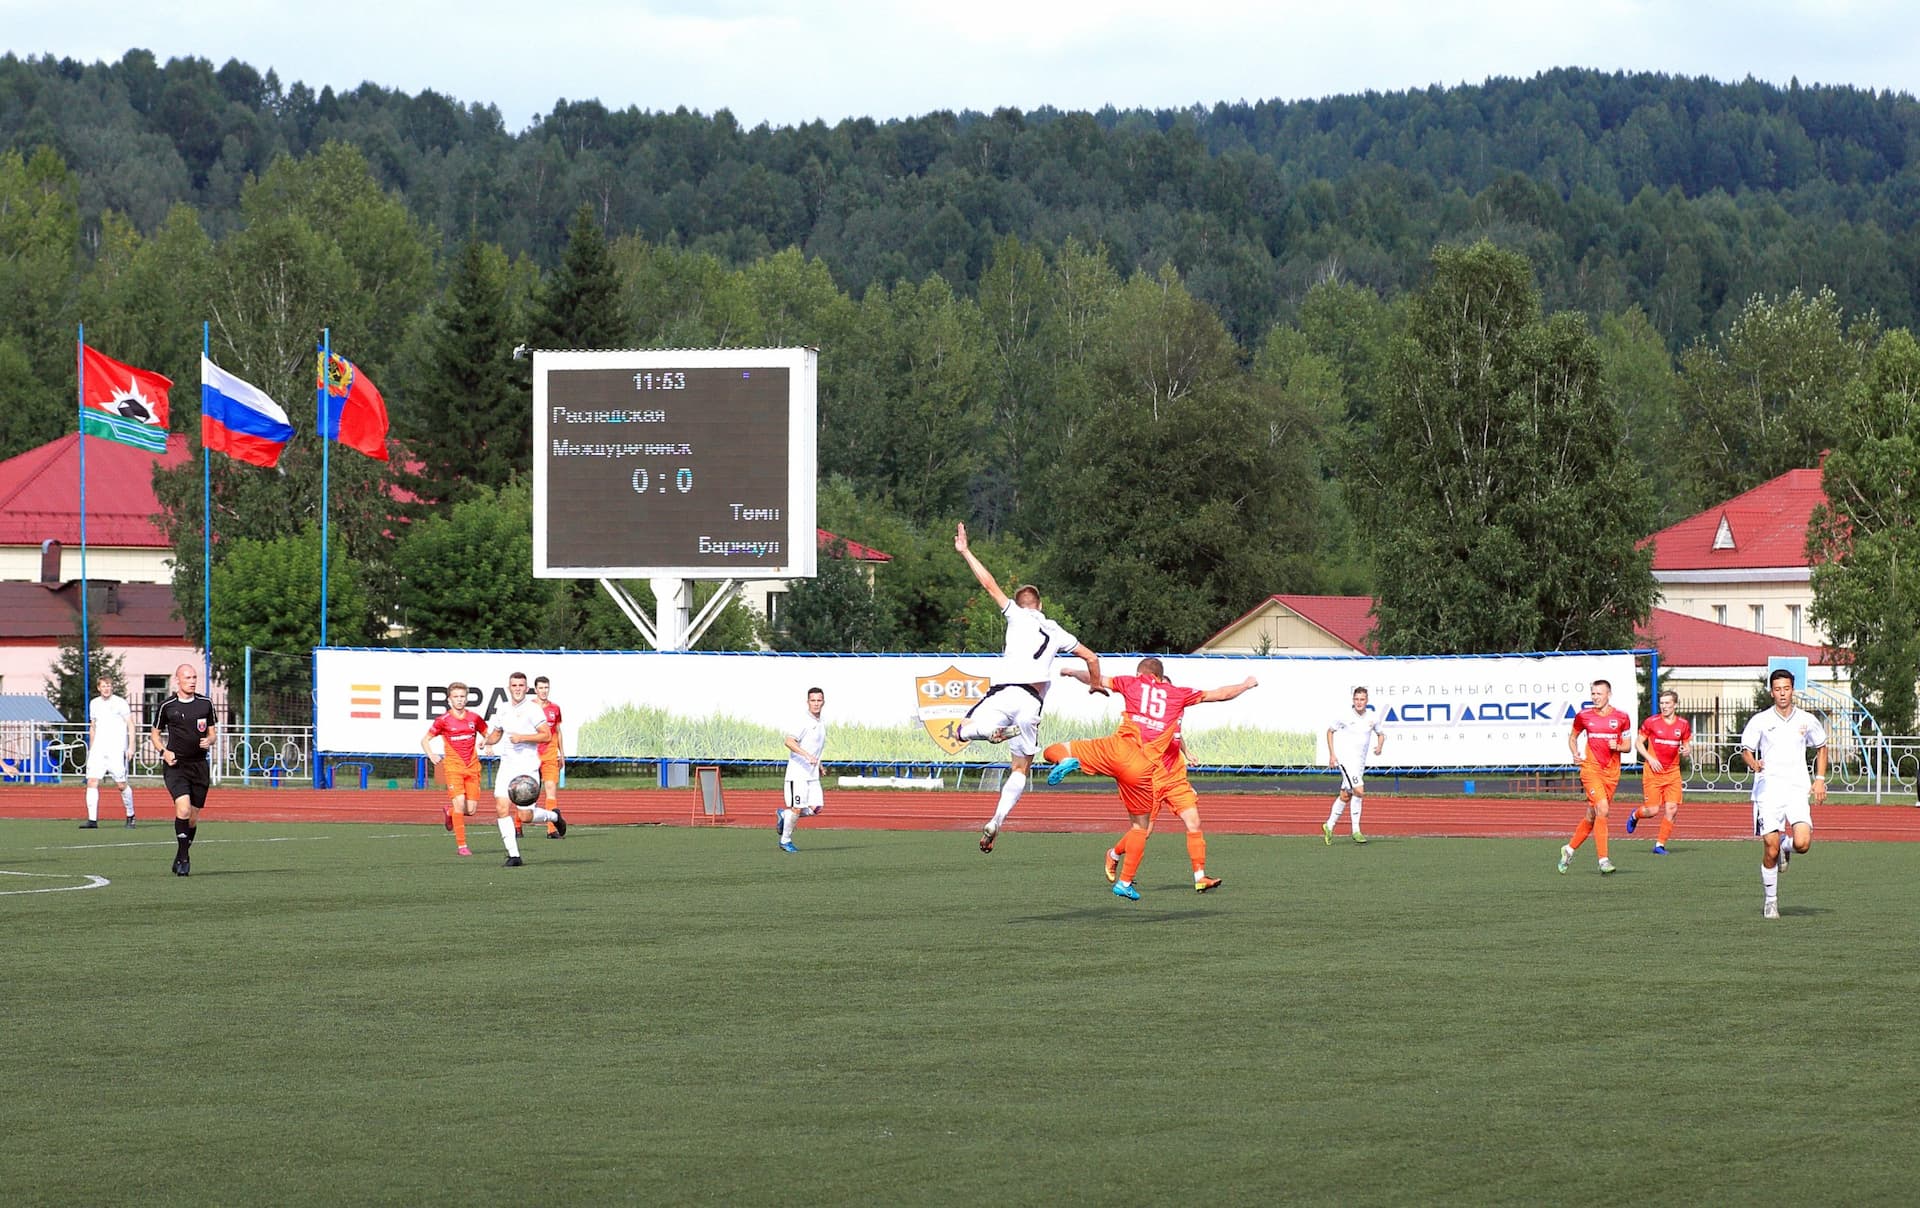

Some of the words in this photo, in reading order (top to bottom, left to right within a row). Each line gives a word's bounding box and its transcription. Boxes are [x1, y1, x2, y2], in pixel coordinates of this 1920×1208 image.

[632, 372, 686, 390] 11:53
[553, 406, 665, 423] Распадская
[553, 439, 692, 458] Междуреченск
[729, 503, 779, 521] Темп
[699, 536, 779, 558] Барнаул
[1033, 627, 1050, 660] 7
[920, 679, 984, 699] ФОК
[1350, 684, 1493, 696] ГНЕРАЛЬНЫЙ
[1504, 683, 1594, 695] СПОНСО
[393, 685, 537, 721] ЕВРА
[794, 795, 801, 805] 9
